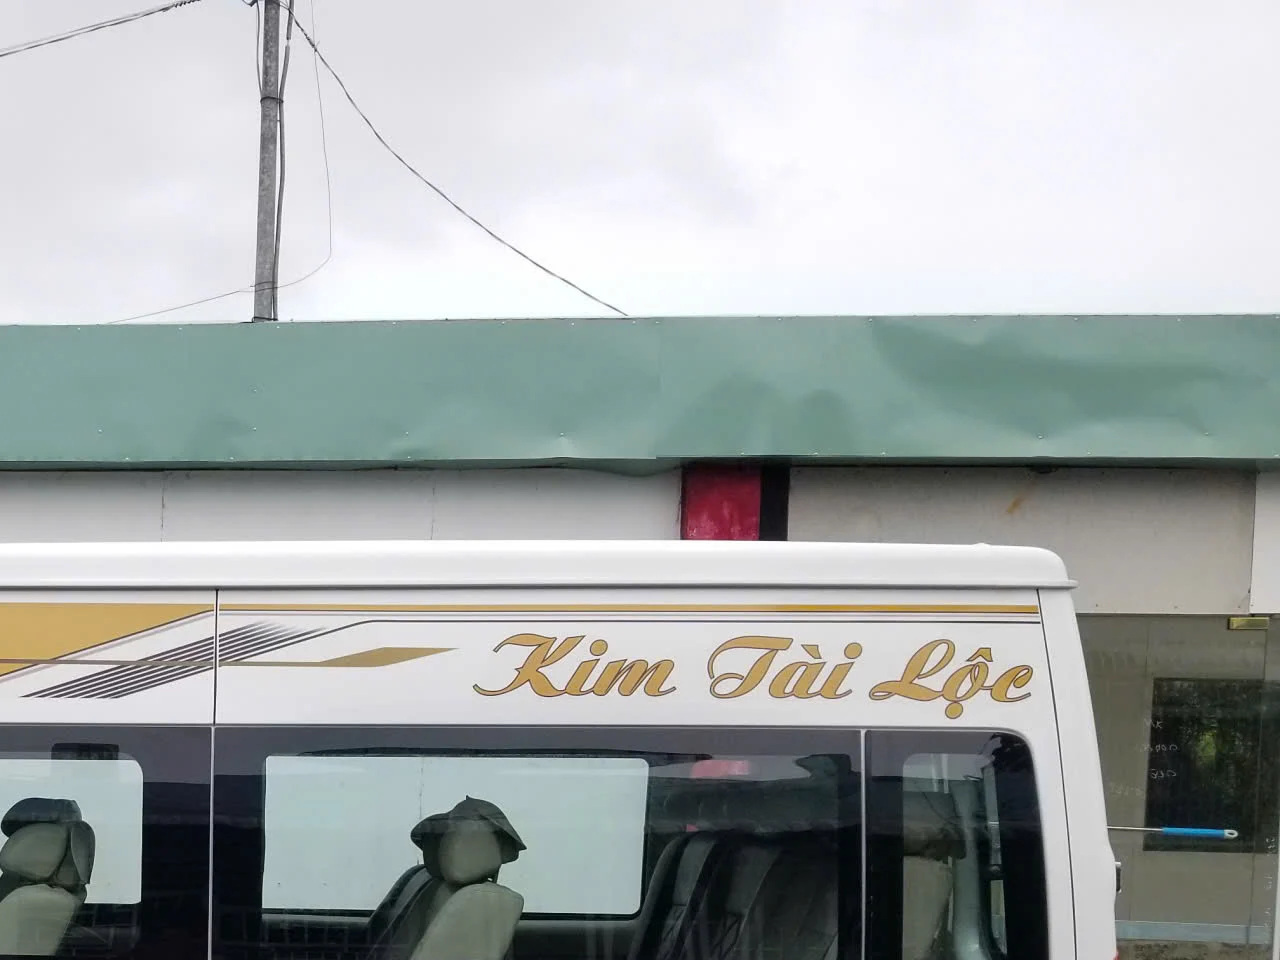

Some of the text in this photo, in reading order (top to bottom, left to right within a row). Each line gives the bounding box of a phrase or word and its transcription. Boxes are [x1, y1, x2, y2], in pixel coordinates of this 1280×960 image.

[472, 633, 1034, 719] Kim Tài Lộc
